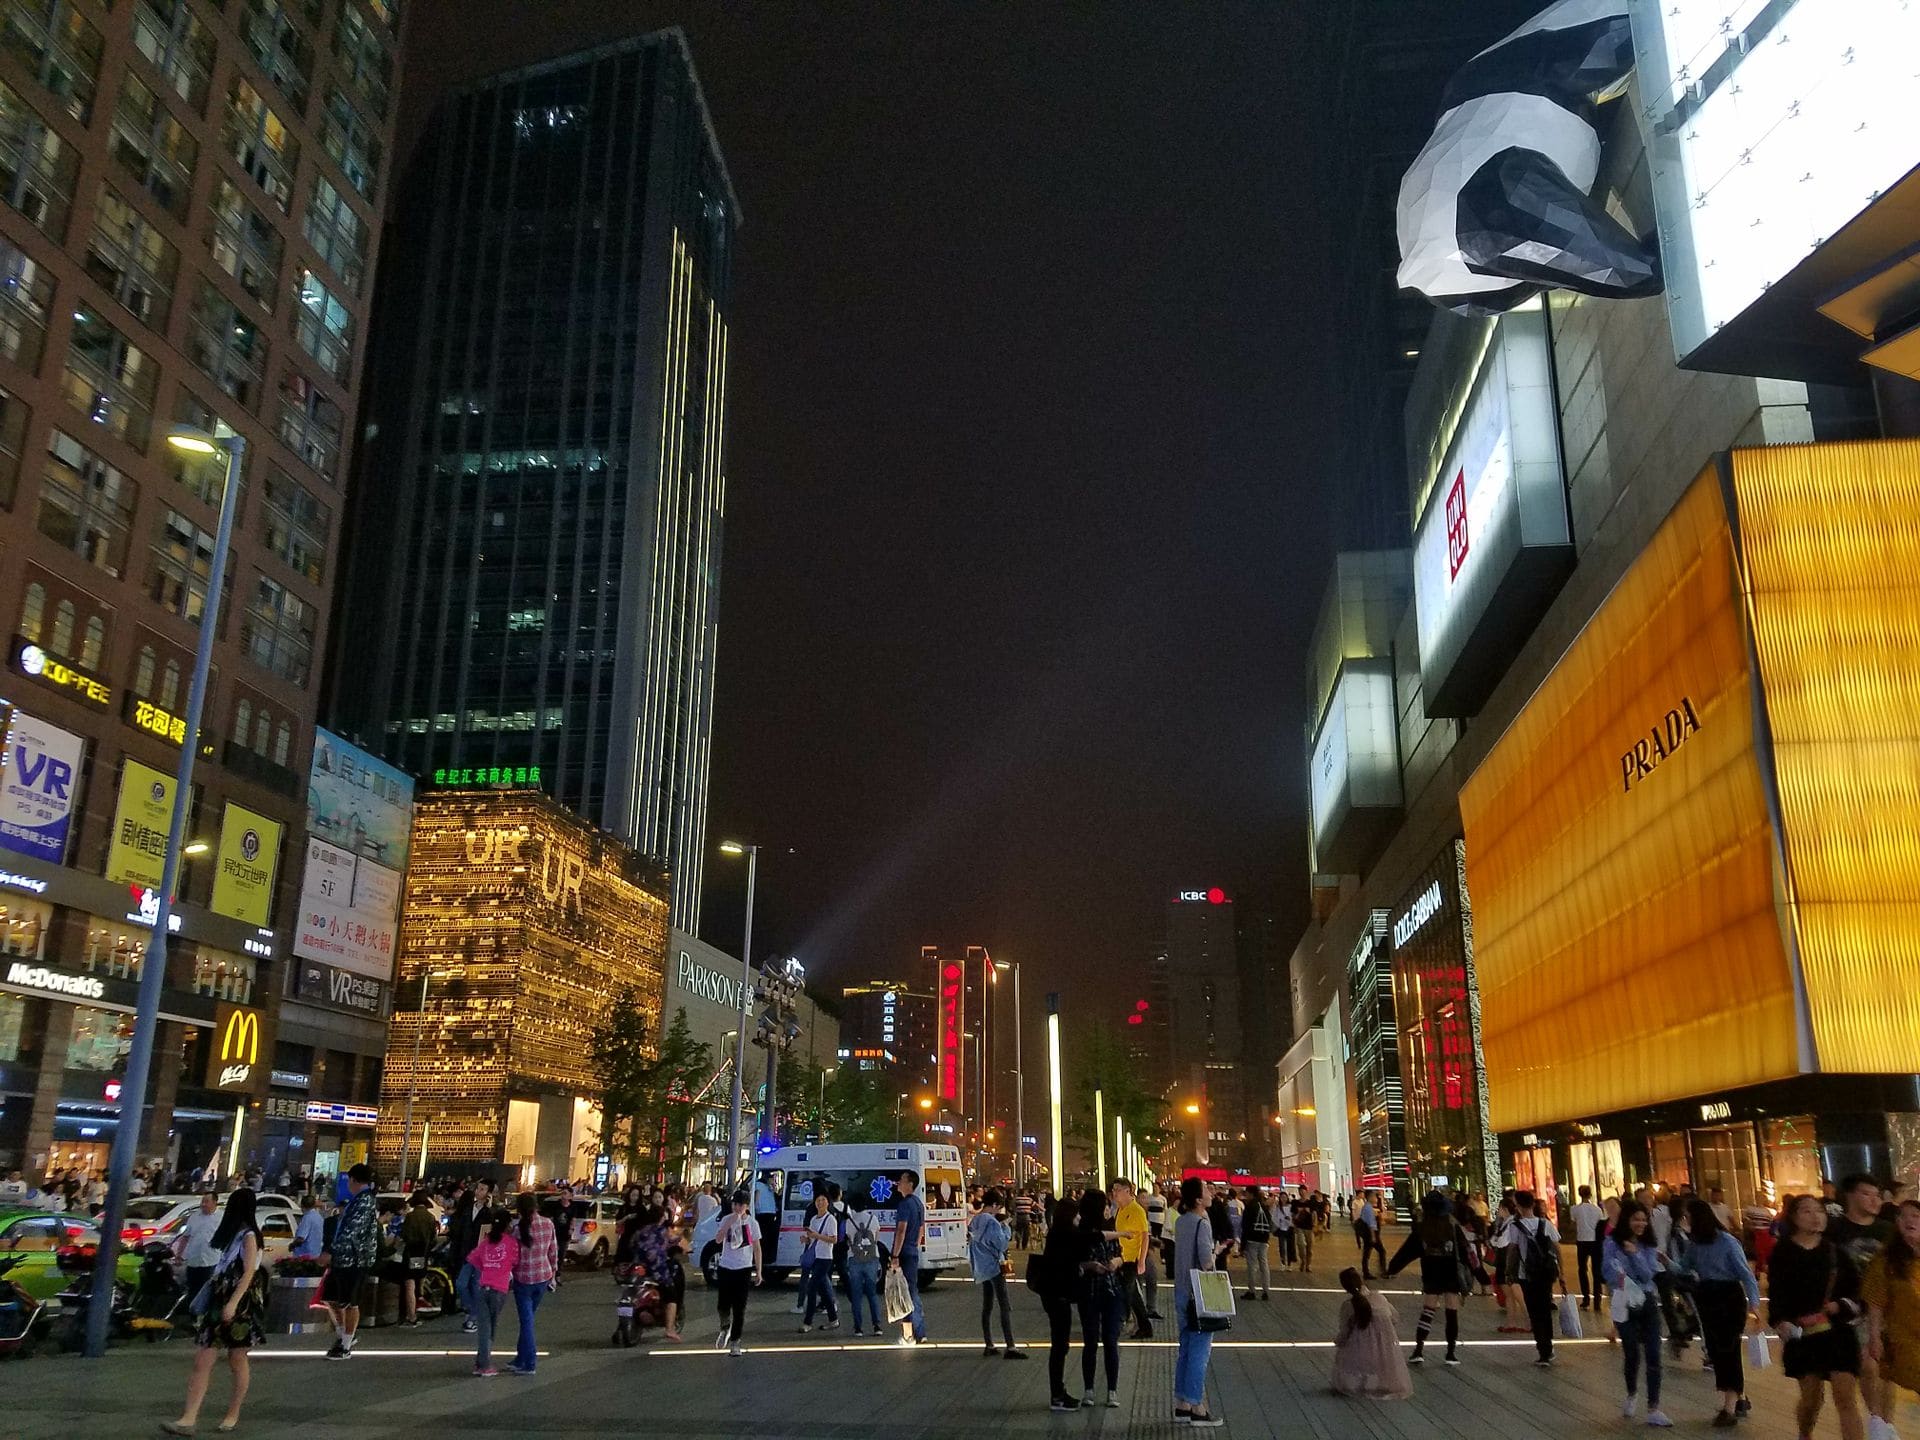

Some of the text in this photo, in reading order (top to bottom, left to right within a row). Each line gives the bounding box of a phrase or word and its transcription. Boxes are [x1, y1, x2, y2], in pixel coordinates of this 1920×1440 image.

[1447, 483, 1463, 533] UNI
[1450, 518, 1467, 569] QLO
[42, 659, 112, 705] COFFEE
[136, 700, 201, 744] 花园餐
[1620, 696, 1702, 793] PRADA
[15, 744, 72, 800] VR
[466, 829, 523, 864] UR
[223, 858, 268, 887] 异次元世界
[320, 879, 336, 897] 5F
[541, 839, 584, 916] UR
[1180, 891, 1207, 901] ICBC
[329, 915, 392, 954] 小天鹅火锅
[7, 962, 104, 998] McDonald's
[330, 969, 352, 1004] VR
[677, 951, 733, 1008] PARKSON
